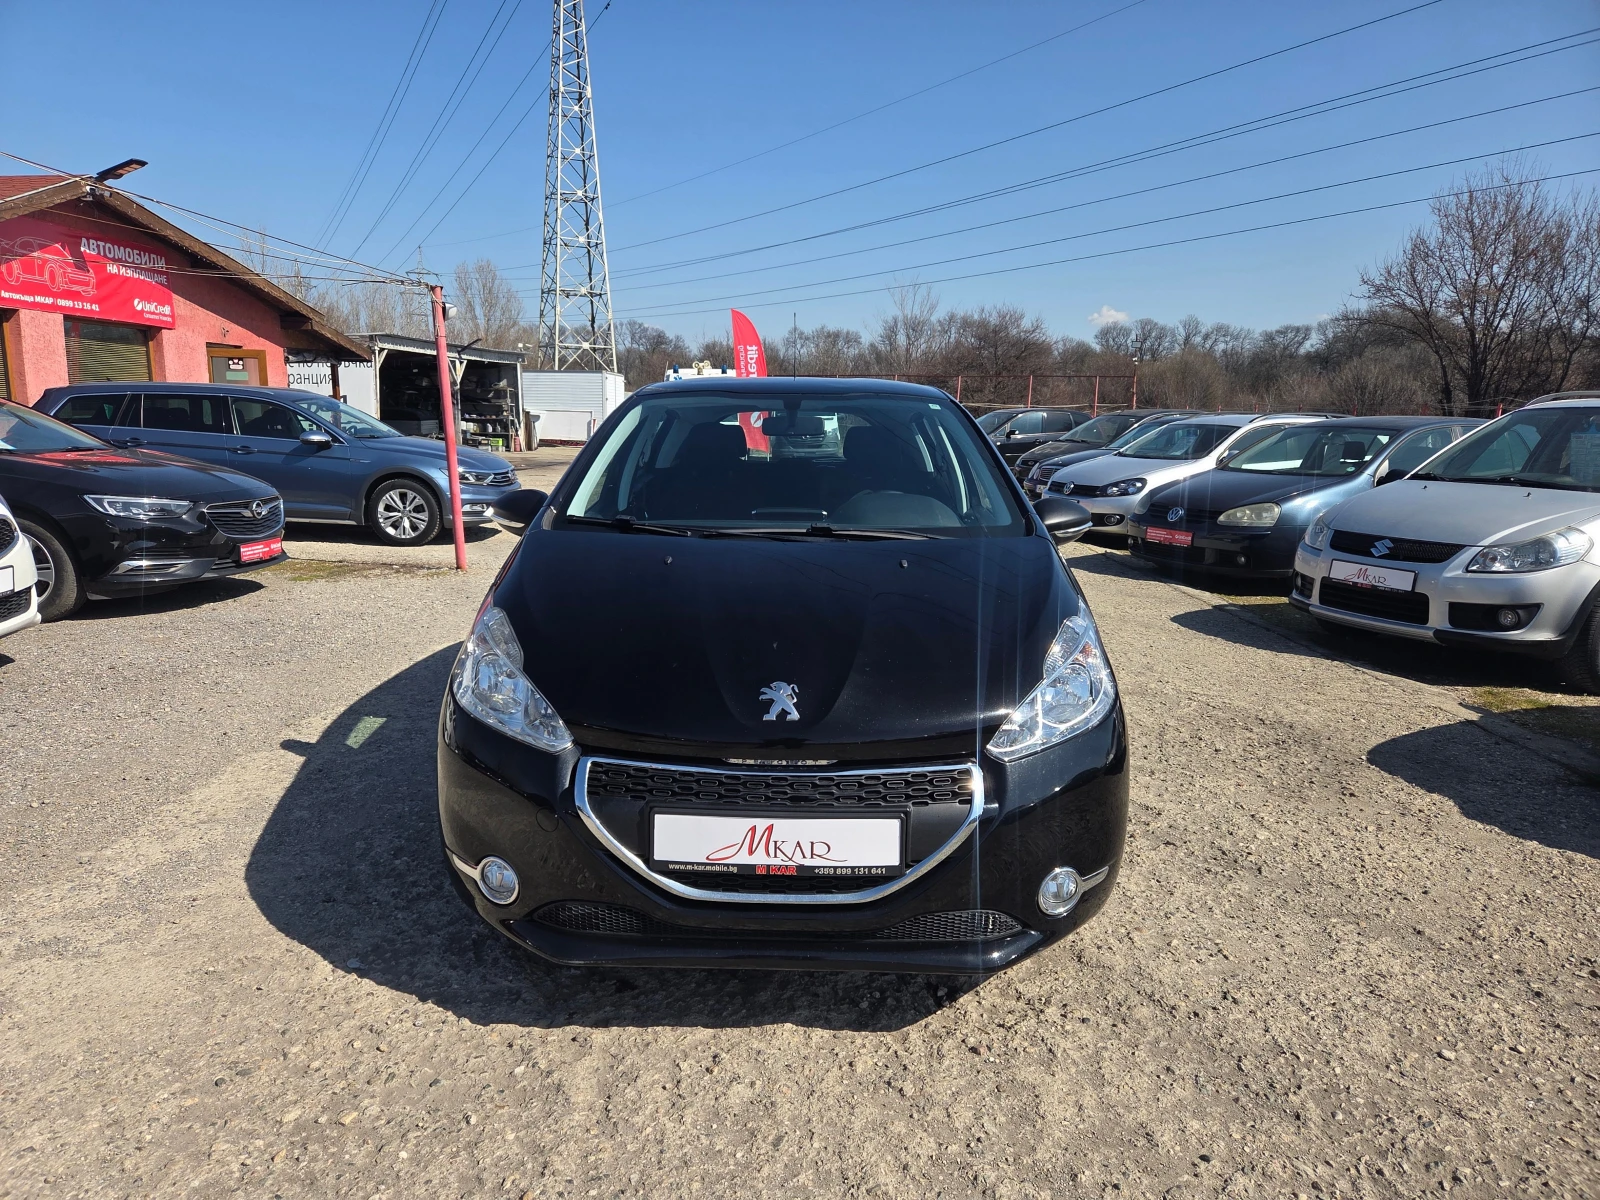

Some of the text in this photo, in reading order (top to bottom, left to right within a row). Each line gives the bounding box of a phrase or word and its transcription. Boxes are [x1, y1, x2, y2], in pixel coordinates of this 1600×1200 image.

[80, 237, 166, 270] АВТОМОБИЛИ
[107, 263, 168, 285] НА ИЗПЛАЩАНЕ
[1, 290, 100, 312] Автокъща МКАР 0899 13 16 41
[142, 300, 172, 316] UniCredit
[287, 373, 333, 387] ранция
[668, 863, 738, 873] www.m-kar.mobile.bg
[755, 864, 797, 876] M KAR
[814, 867, 886, 875] +359 899 131 641
